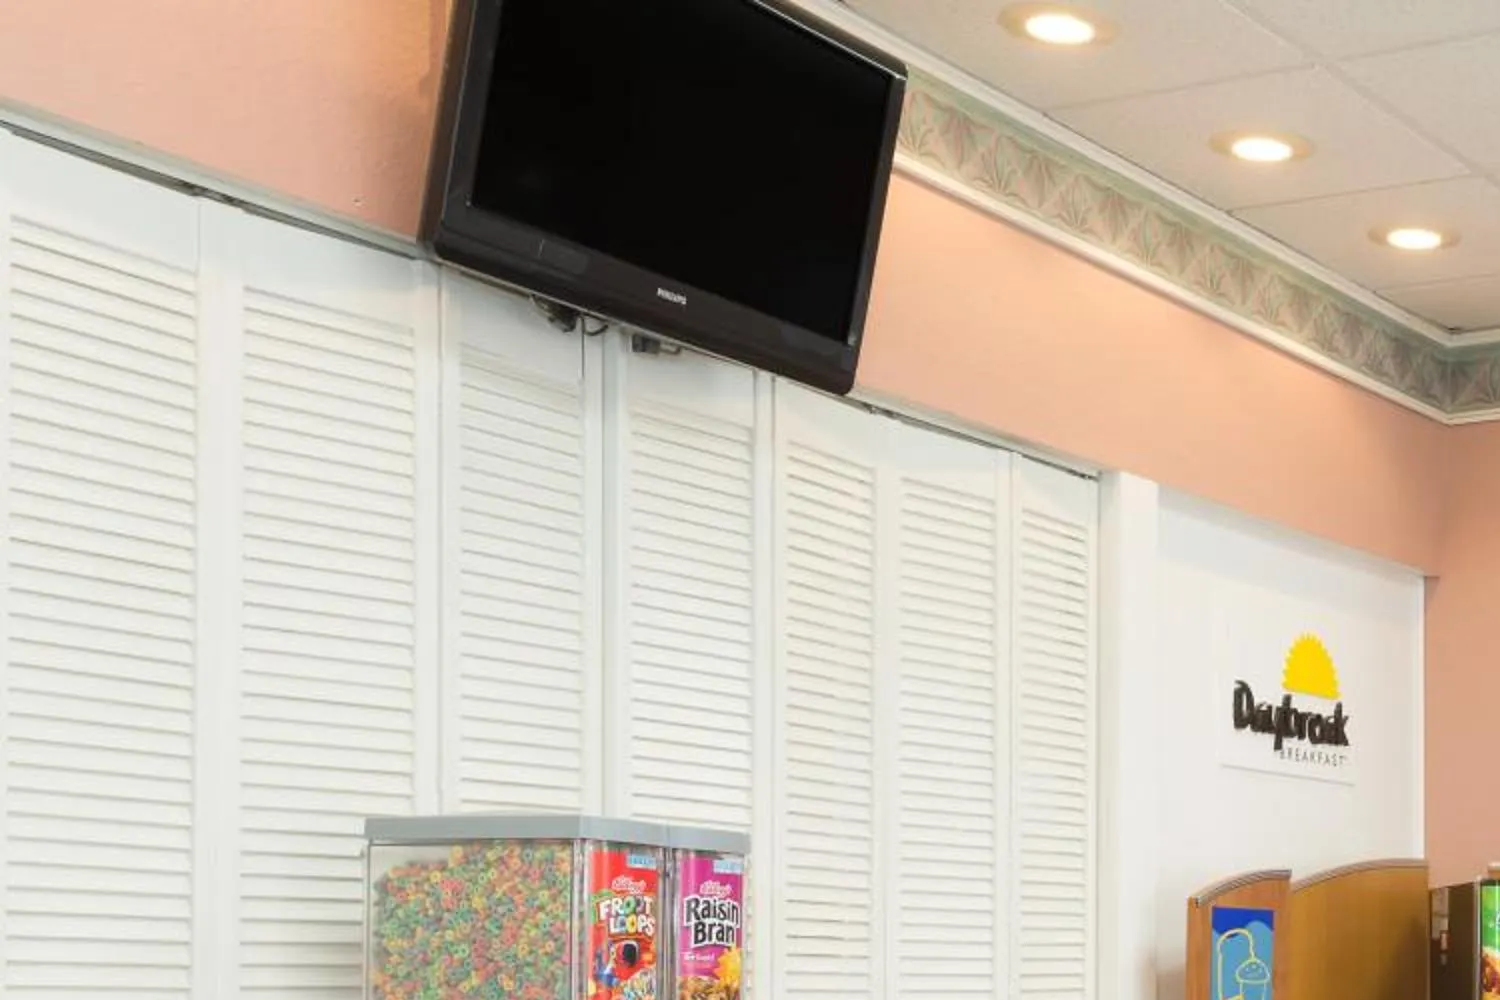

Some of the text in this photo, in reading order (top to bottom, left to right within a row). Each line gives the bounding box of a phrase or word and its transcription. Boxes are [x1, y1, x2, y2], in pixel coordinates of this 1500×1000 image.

[1233, 679, 1349, 752] Daybreak
[1279, 748, 1344, 767] BREAKFAST
[685, 897, 739, 923] Raisin
[693, 921, 735, 946] Bran
